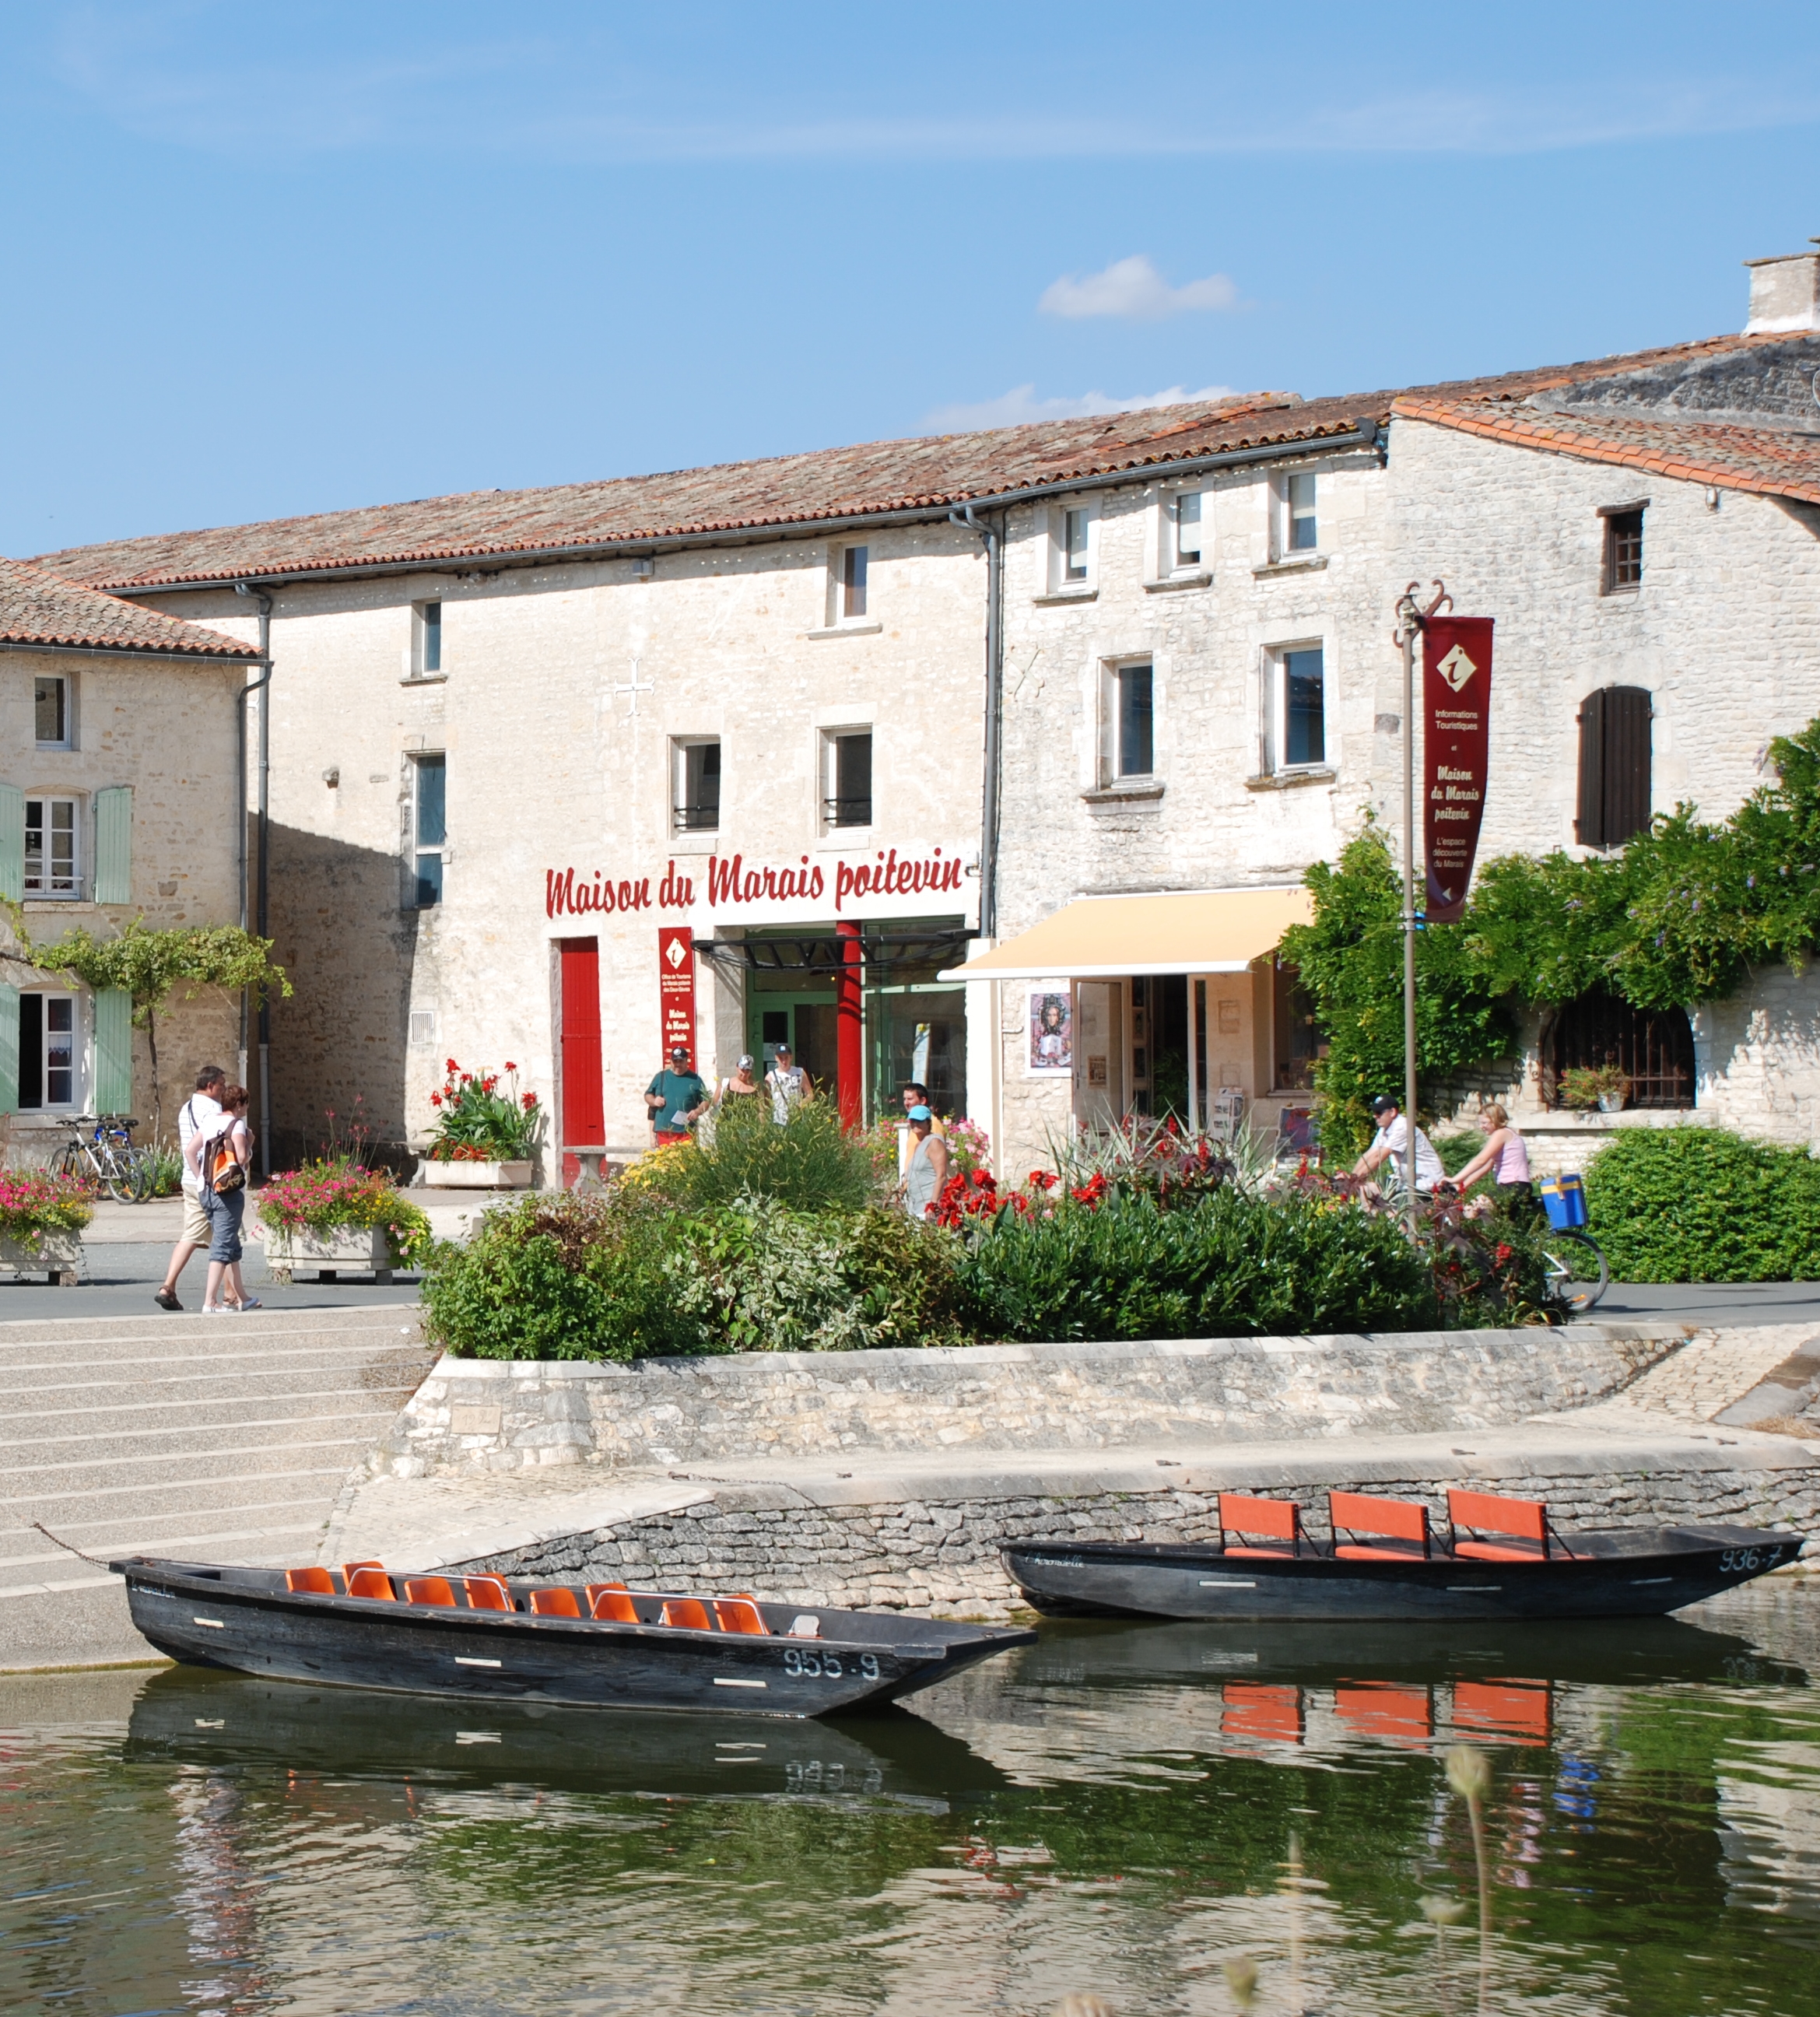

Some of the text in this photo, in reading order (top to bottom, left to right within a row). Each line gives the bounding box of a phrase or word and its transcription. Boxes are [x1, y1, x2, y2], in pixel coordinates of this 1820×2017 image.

[1435, 709, 1478, 719] Informations
[1435, 720, 1478, 731] Touristiques
[1437, 765, 1472, 780] Maison
[1431, 785, 1479, 802] du Marais
[1434, 806, 1470, 823] poitevin
[546, 847, 964, 919] Maison du Marais poitevin
